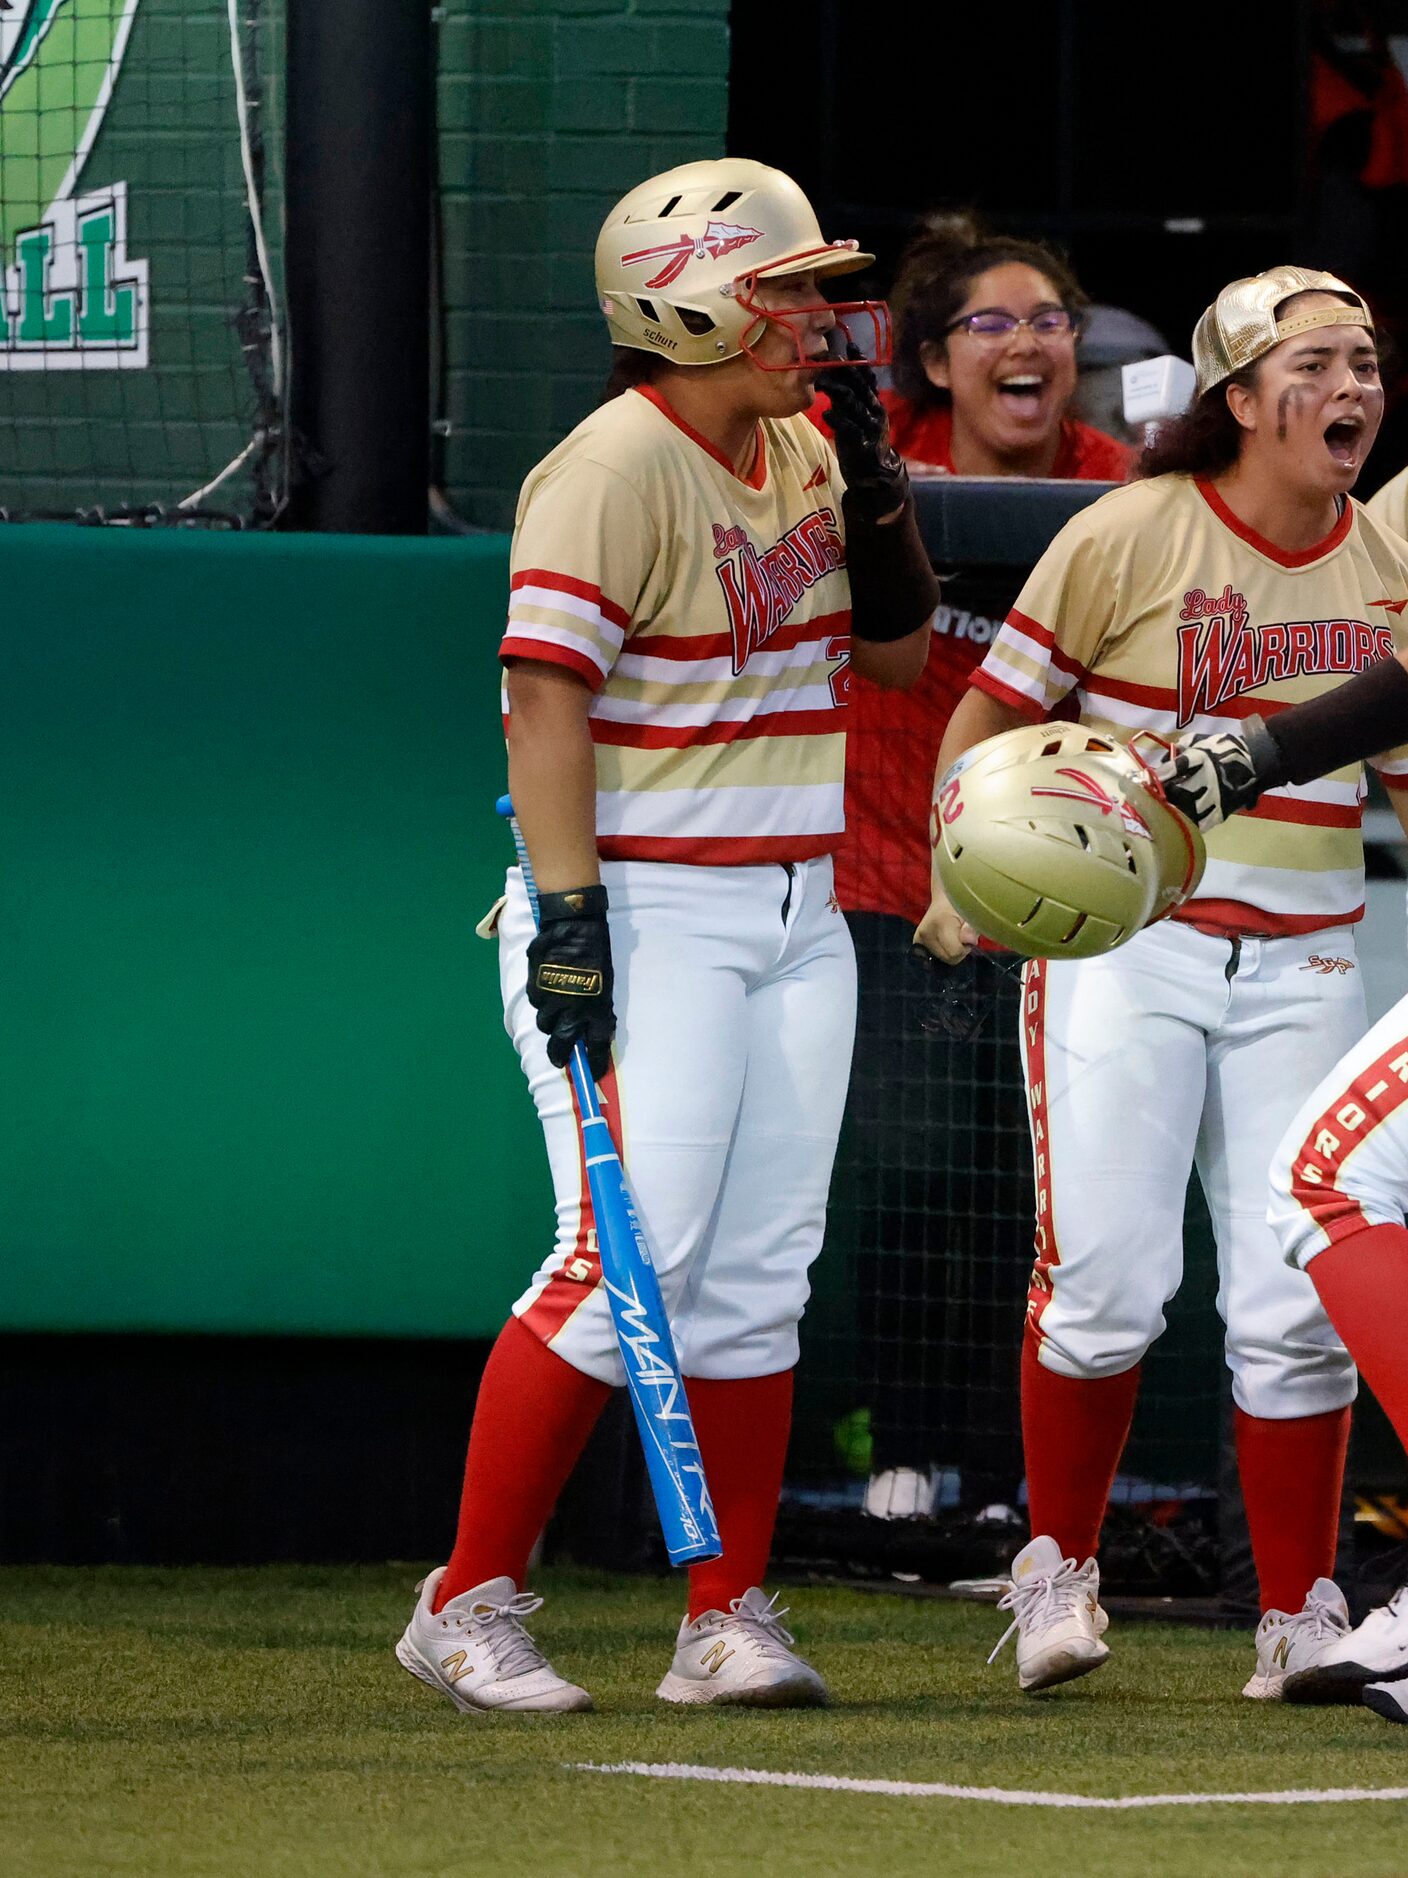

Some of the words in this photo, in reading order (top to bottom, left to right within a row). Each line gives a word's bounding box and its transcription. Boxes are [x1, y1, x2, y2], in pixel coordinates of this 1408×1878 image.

[0, 200, 138, 352] LL
[643, 328, 678, 350] schutt
[1179, 584, 1247, 621] Lady
[1177, 612, 1395, 729] WARRIORS
[1028, 959, 1039, 1047] ADY
